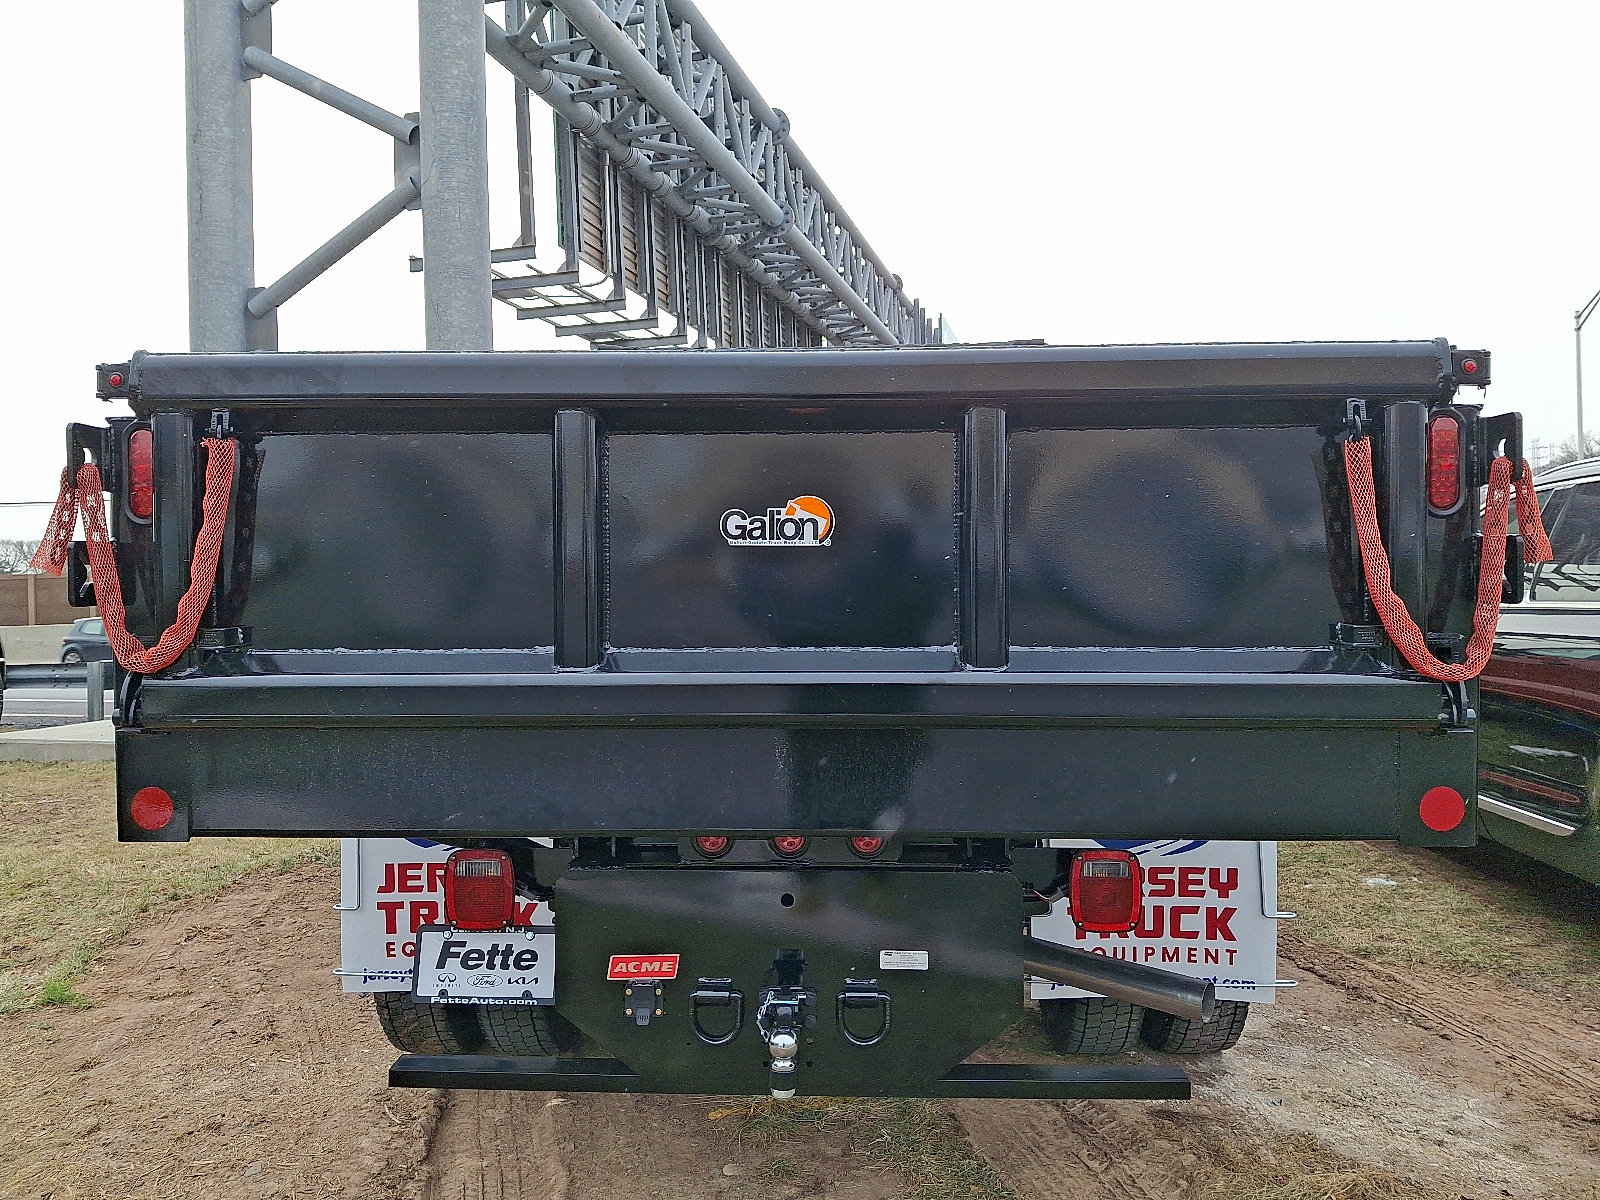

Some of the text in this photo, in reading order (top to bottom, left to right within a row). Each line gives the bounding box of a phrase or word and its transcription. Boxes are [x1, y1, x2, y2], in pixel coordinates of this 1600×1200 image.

[721, 509, 820, 541] Galion
[377, 863, 447, 893] JER
[1141, 866, 1239, 898] SEY
[377, 901, 539, 935] TRK
[1067, 905, 1238, 942] UCK
[435, 941, 539, 970] Fette
[613, 961, 675, 973] ACME
[1075, 946, 1238, 966] QUIPMENT
[430, 996, 538, 1006] FetteAuto.com
